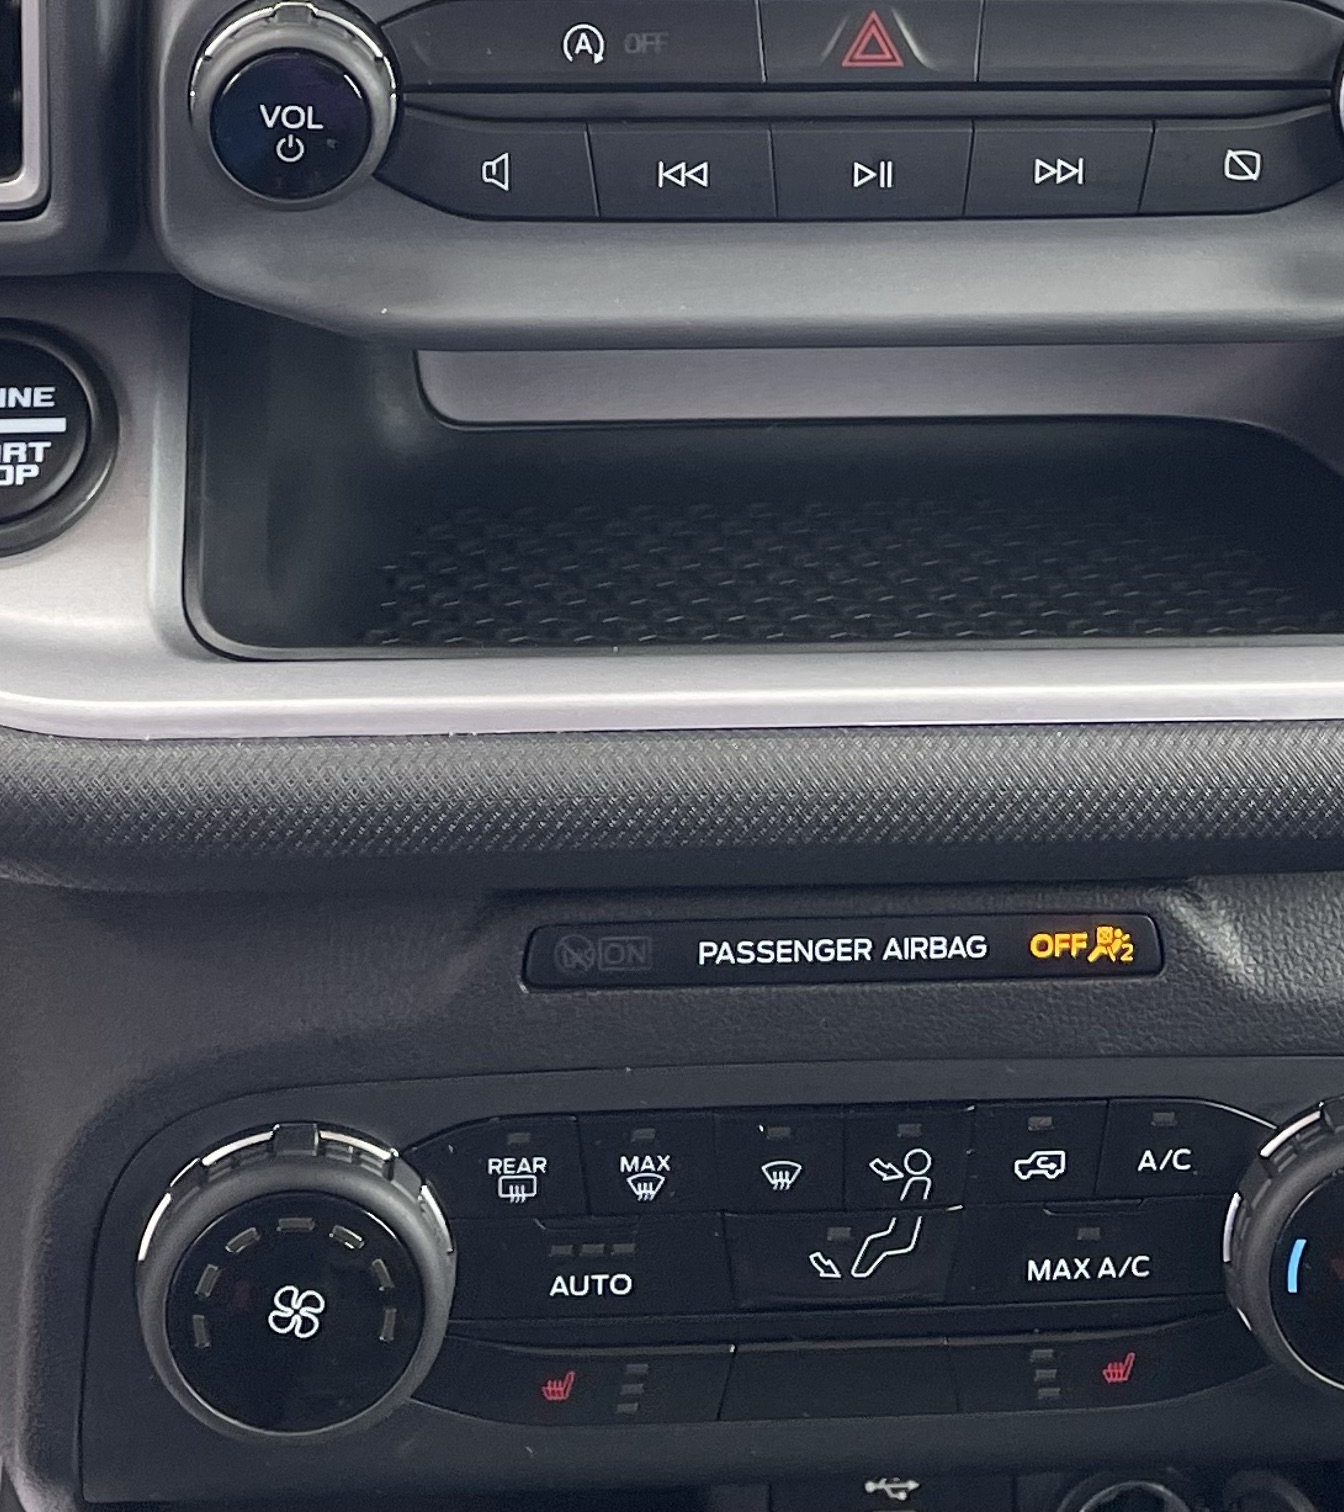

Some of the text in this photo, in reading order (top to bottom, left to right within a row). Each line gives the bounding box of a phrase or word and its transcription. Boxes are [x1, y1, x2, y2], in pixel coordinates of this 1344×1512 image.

[259, 104, 324, 131] VOL
[697, 938, 873, 966] PASSENGER
[882, 934, 988, 960] AIRBAG
[1029, 931, 1088, 959] OFF
[488, 1157, 546, 1174] REAR
[619, 1155, 671, 1172] MAX
[1137, 1148, 1192, 1172] A/C
[1027, 1256, 1151, 1282] MAX A/C
[549, 1273, 633, 1297] AUTO
